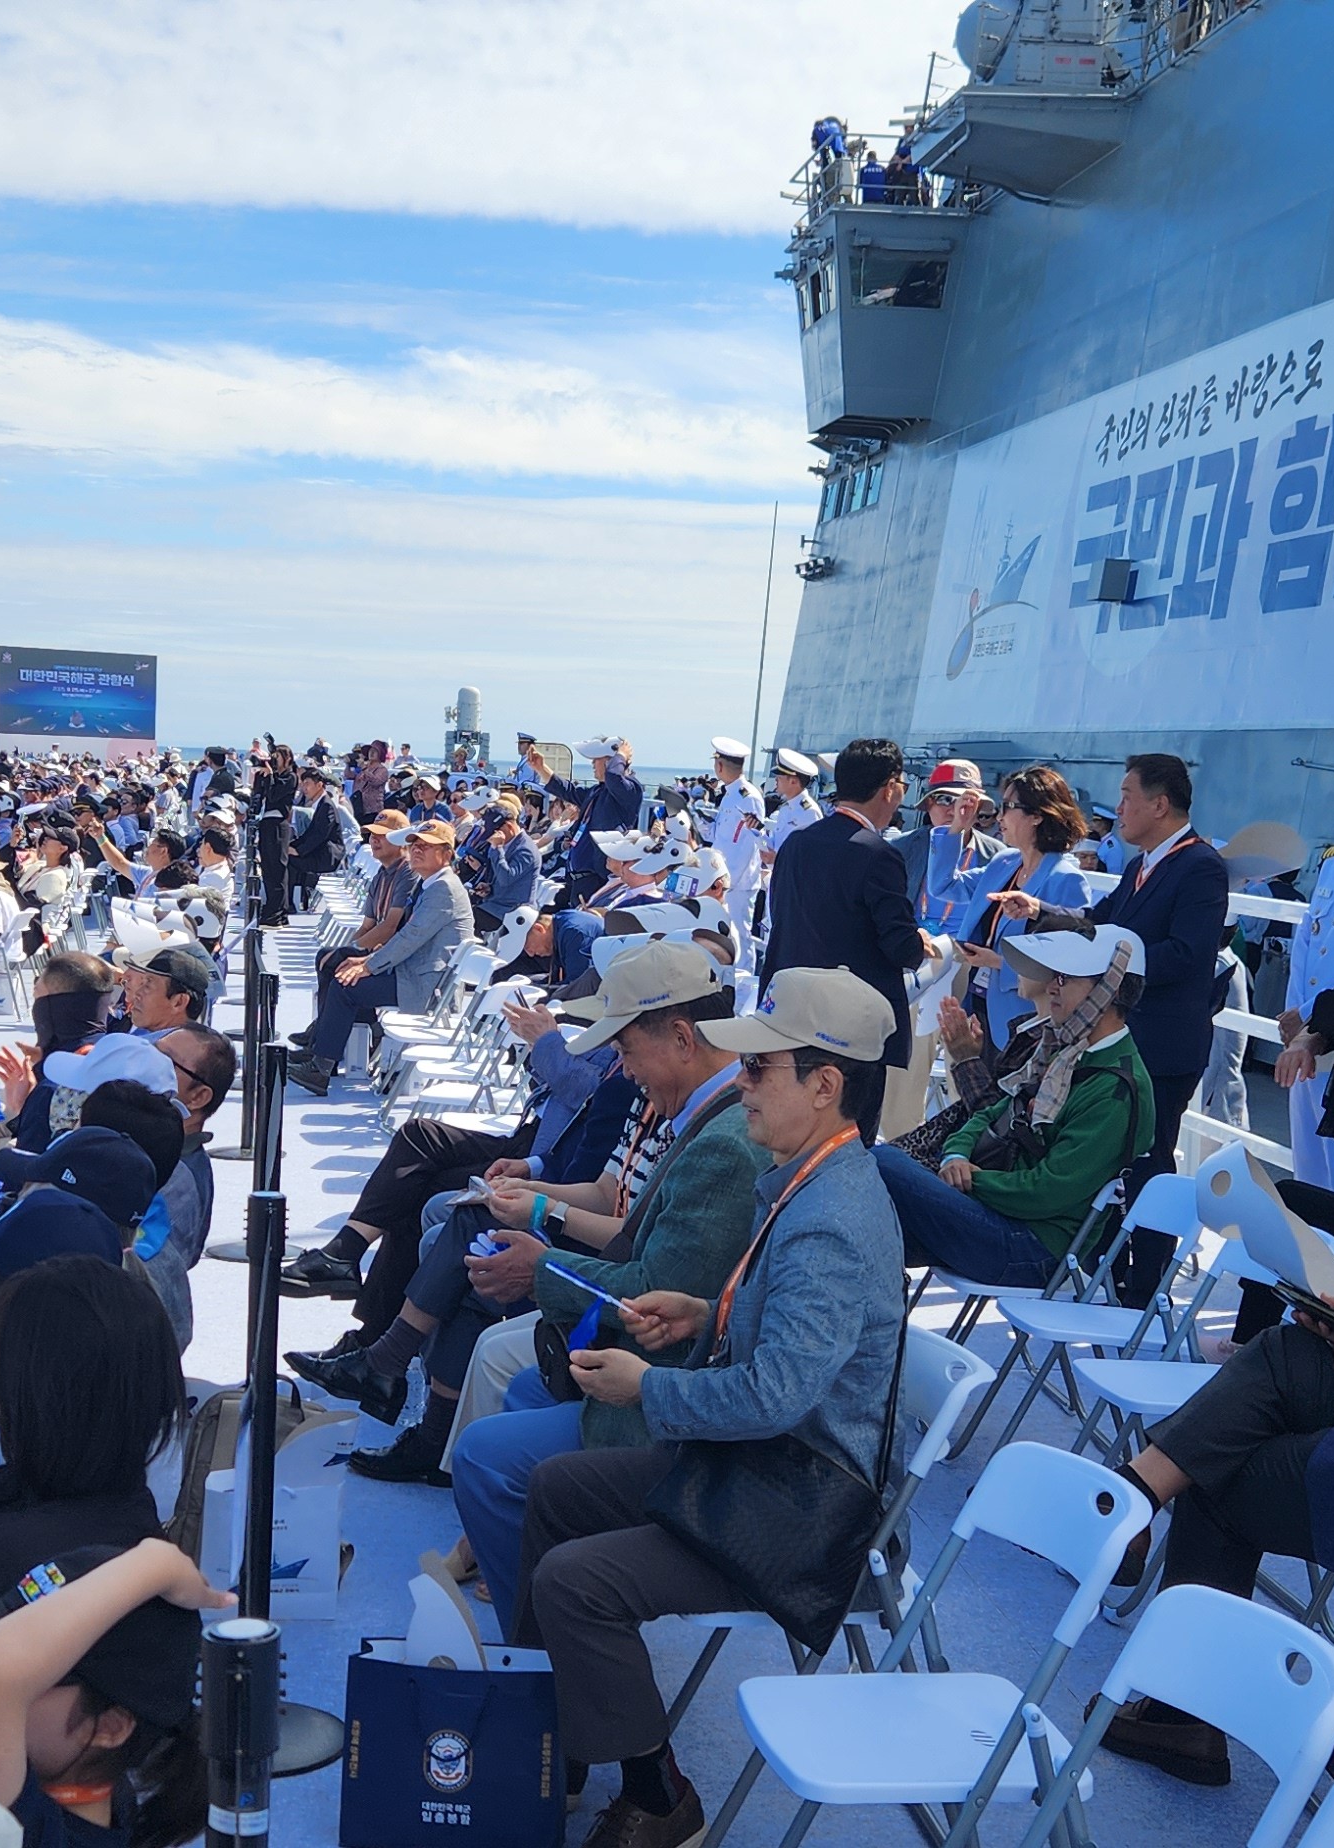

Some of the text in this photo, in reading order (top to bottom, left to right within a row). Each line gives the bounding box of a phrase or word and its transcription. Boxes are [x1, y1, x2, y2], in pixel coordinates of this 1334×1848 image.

[1095, 338, 1325, 468] 국민의 신뢰를 바탕으로
[1068, 437, 1259, 635] 국민과
[19, 668, 96, 685] 대한민국해군
[98, 673, 135, 687] 관함식
